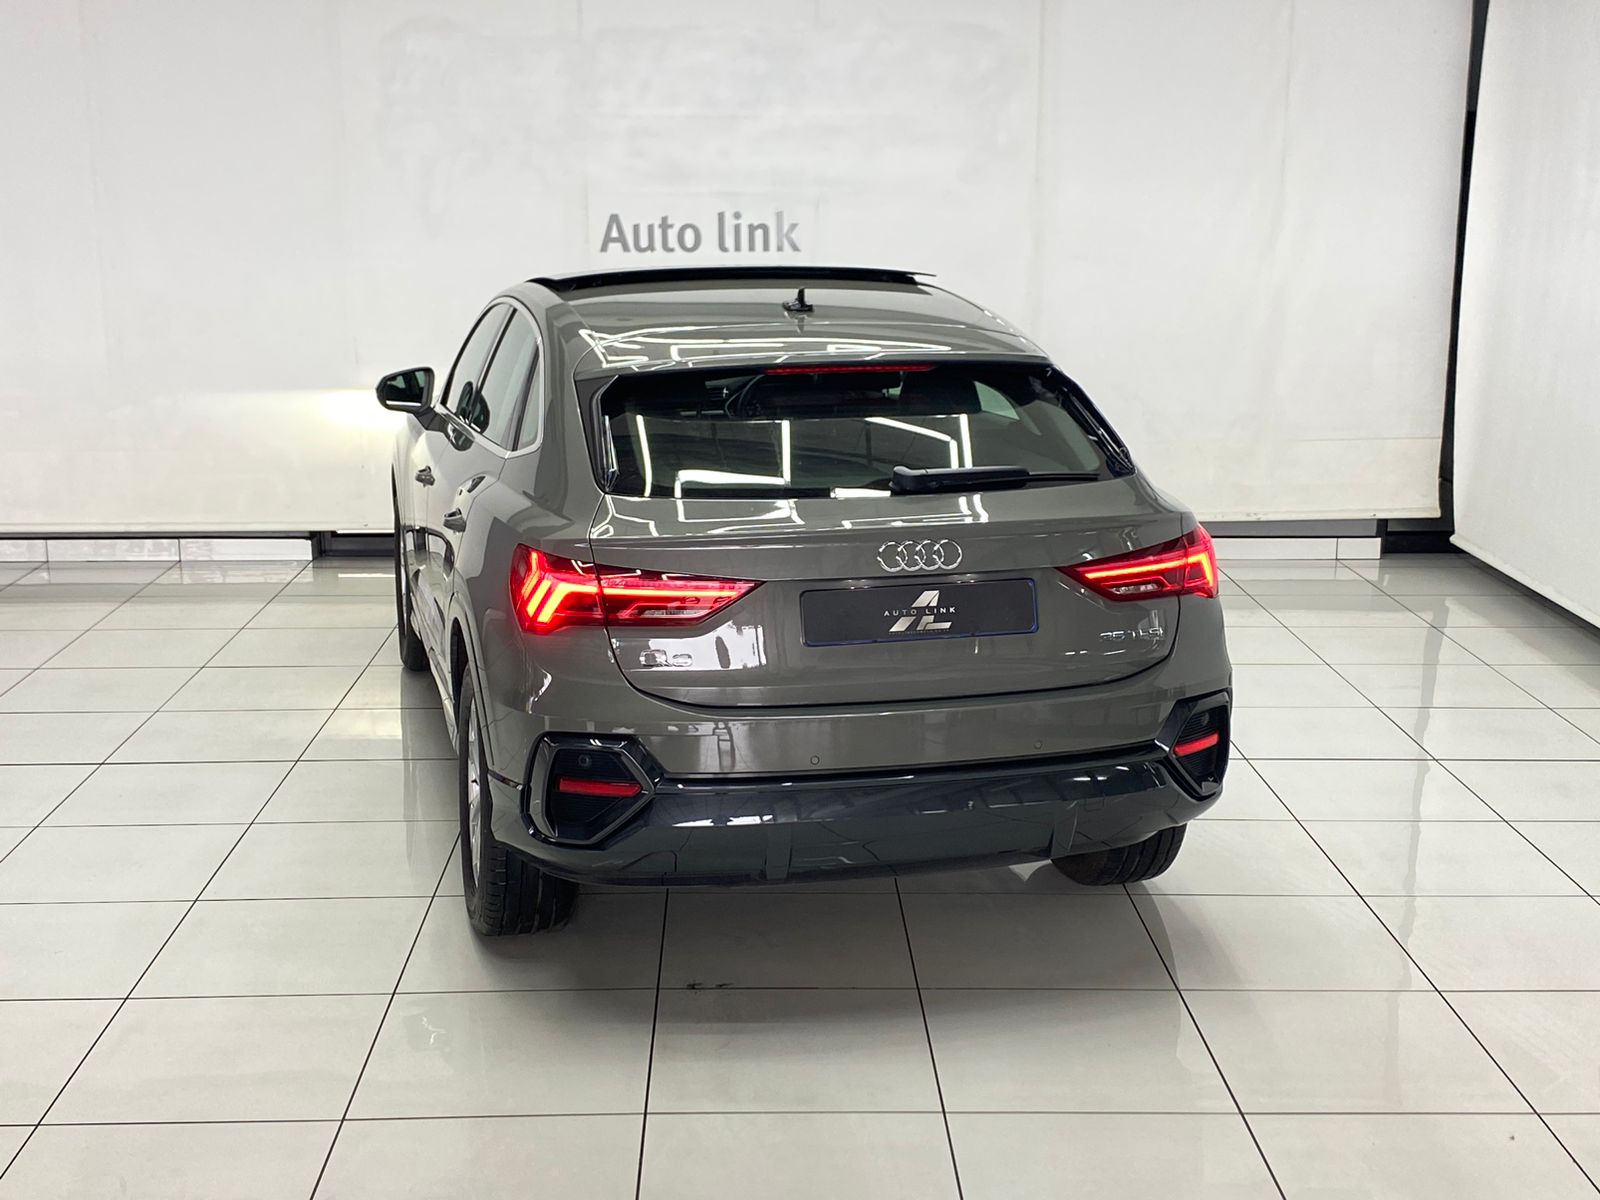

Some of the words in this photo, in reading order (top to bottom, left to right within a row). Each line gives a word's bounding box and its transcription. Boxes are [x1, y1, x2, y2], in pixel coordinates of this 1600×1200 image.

[600, 213, 702, 253] Auto
[717, 210, 801, 253] link
[884, 609, 917, 617] AUTO
